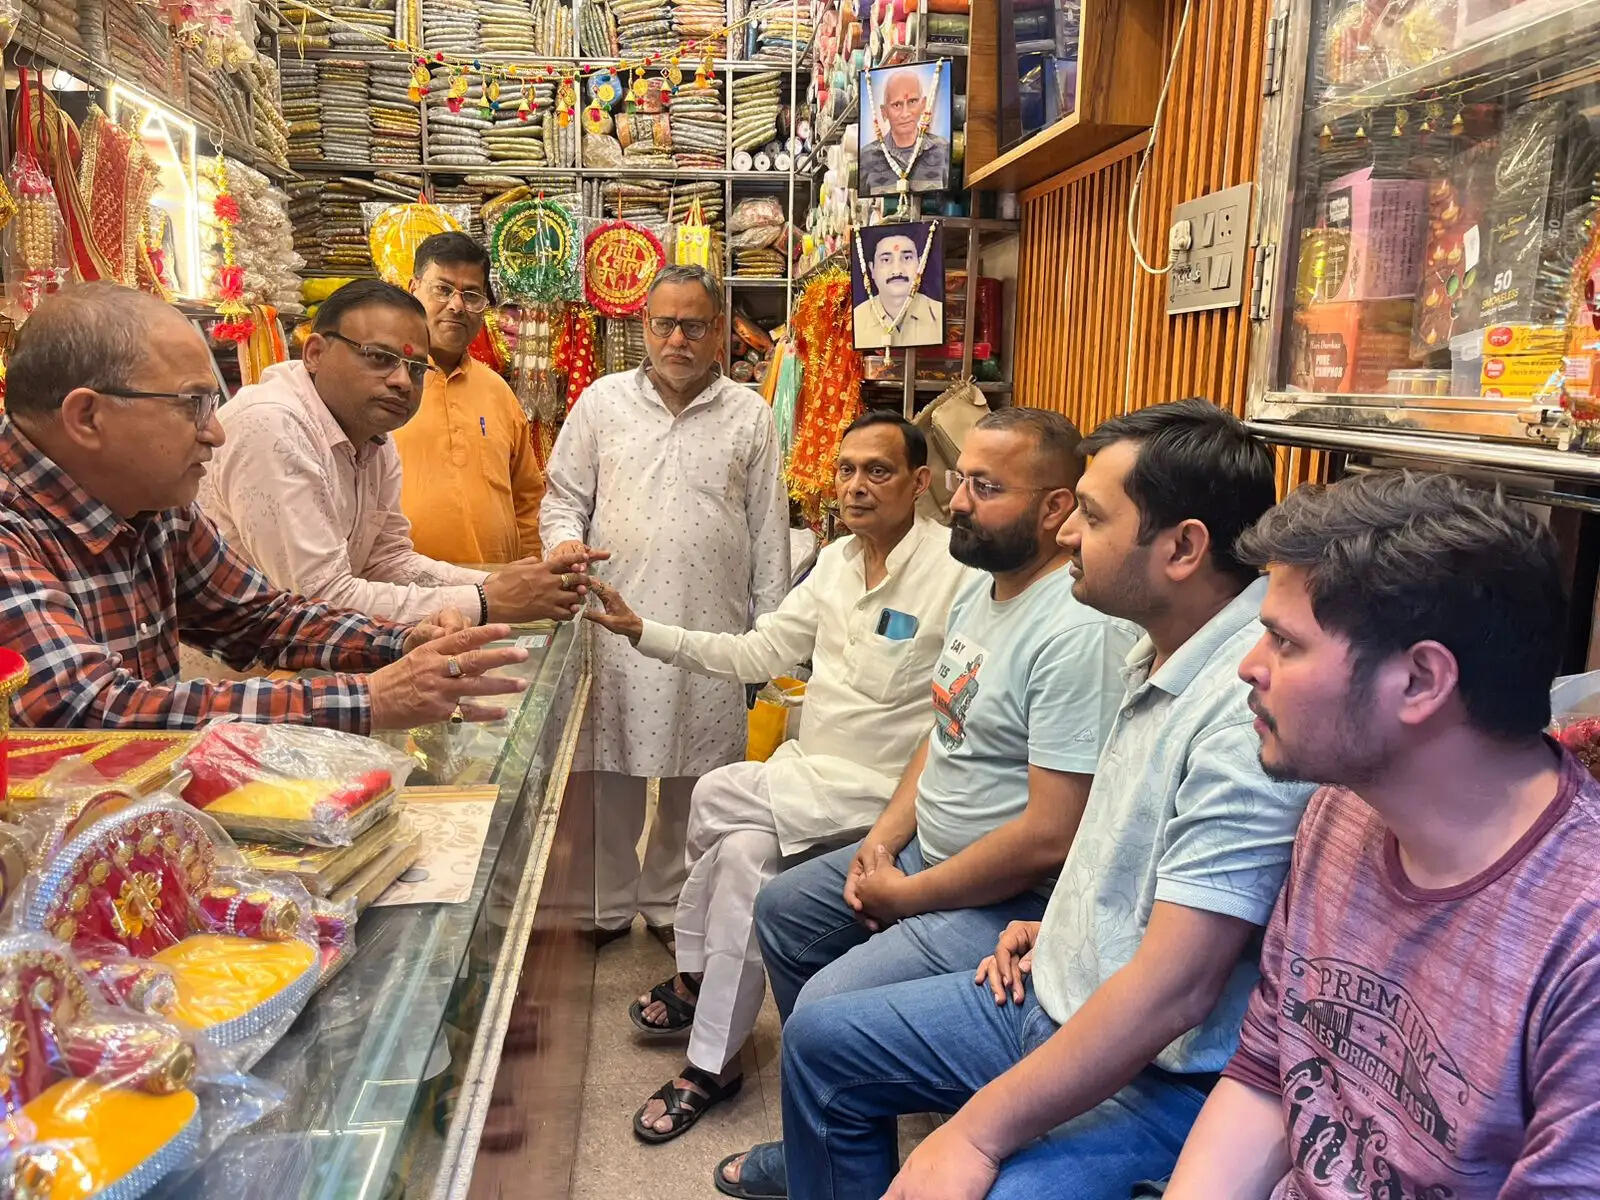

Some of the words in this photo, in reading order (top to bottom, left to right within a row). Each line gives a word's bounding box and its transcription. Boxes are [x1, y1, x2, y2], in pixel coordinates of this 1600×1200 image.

[1493, 269, 1513, 293] 50
[1315, 354, 1331, 366] PURE
[949, 639, 966, 655] SAY
[937, 663, 951, 679] YES
[1318, 966, 1438, 1081] PREMIUM
